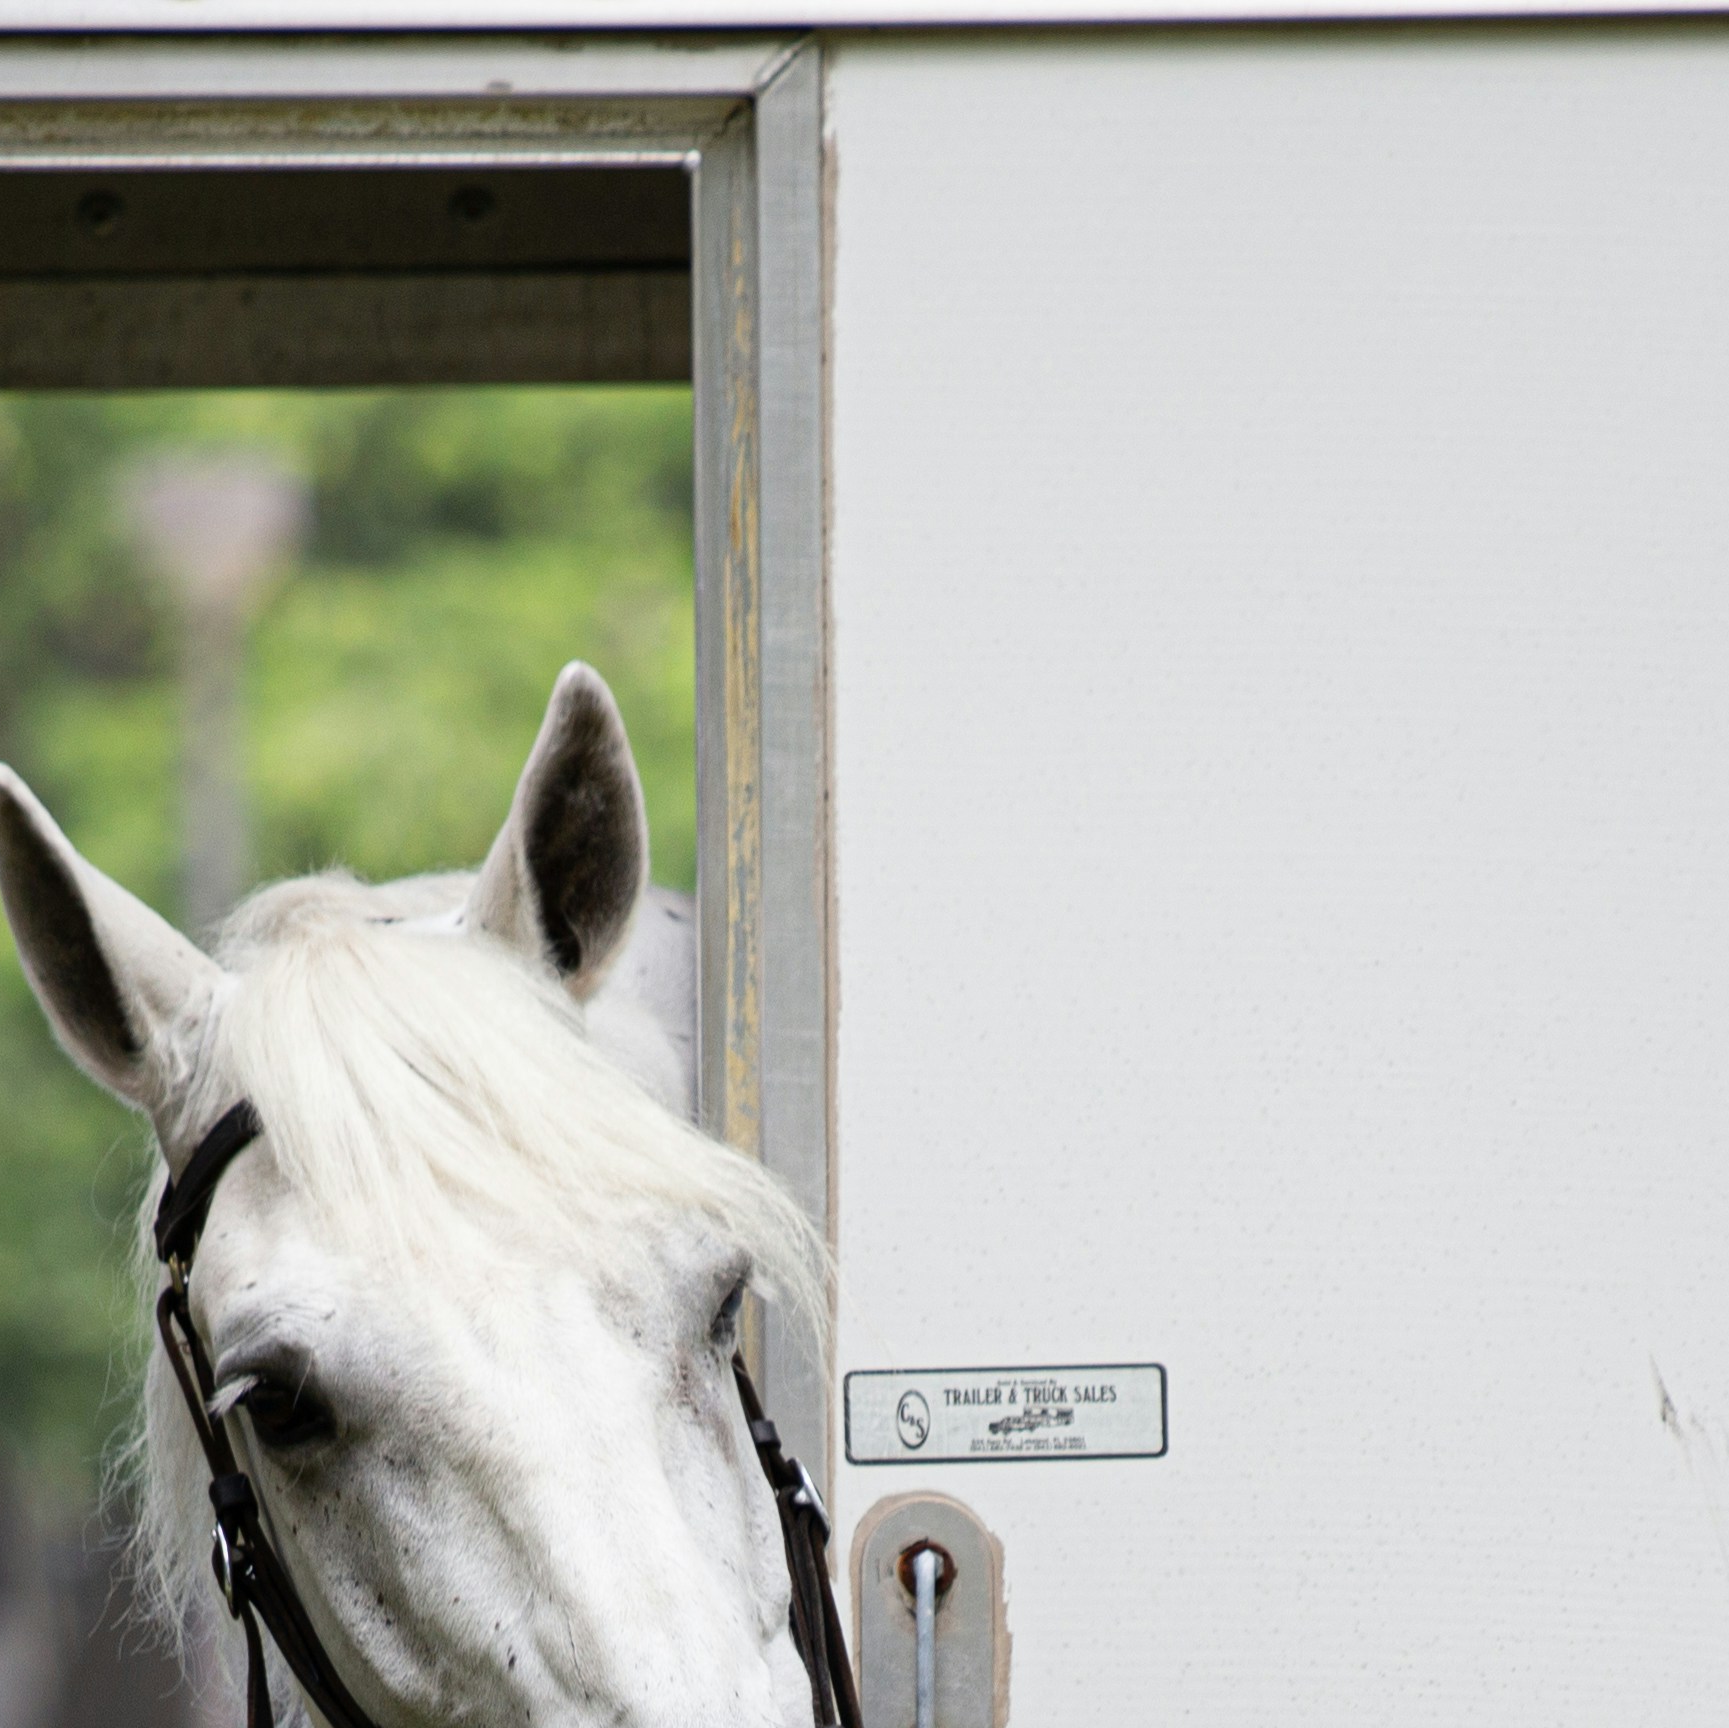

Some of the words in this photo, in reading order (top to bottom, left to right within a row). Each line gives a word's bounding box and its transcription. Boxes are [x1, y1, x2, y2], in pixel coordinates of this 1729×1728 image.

[944, 1388, 1002, 1406] TRAILER
[1008, 1387, 1017, 1404] &
[1024, 1386, 1068, 1404] TRUCK
[1073, 1385, 1117, 1403] SALES
